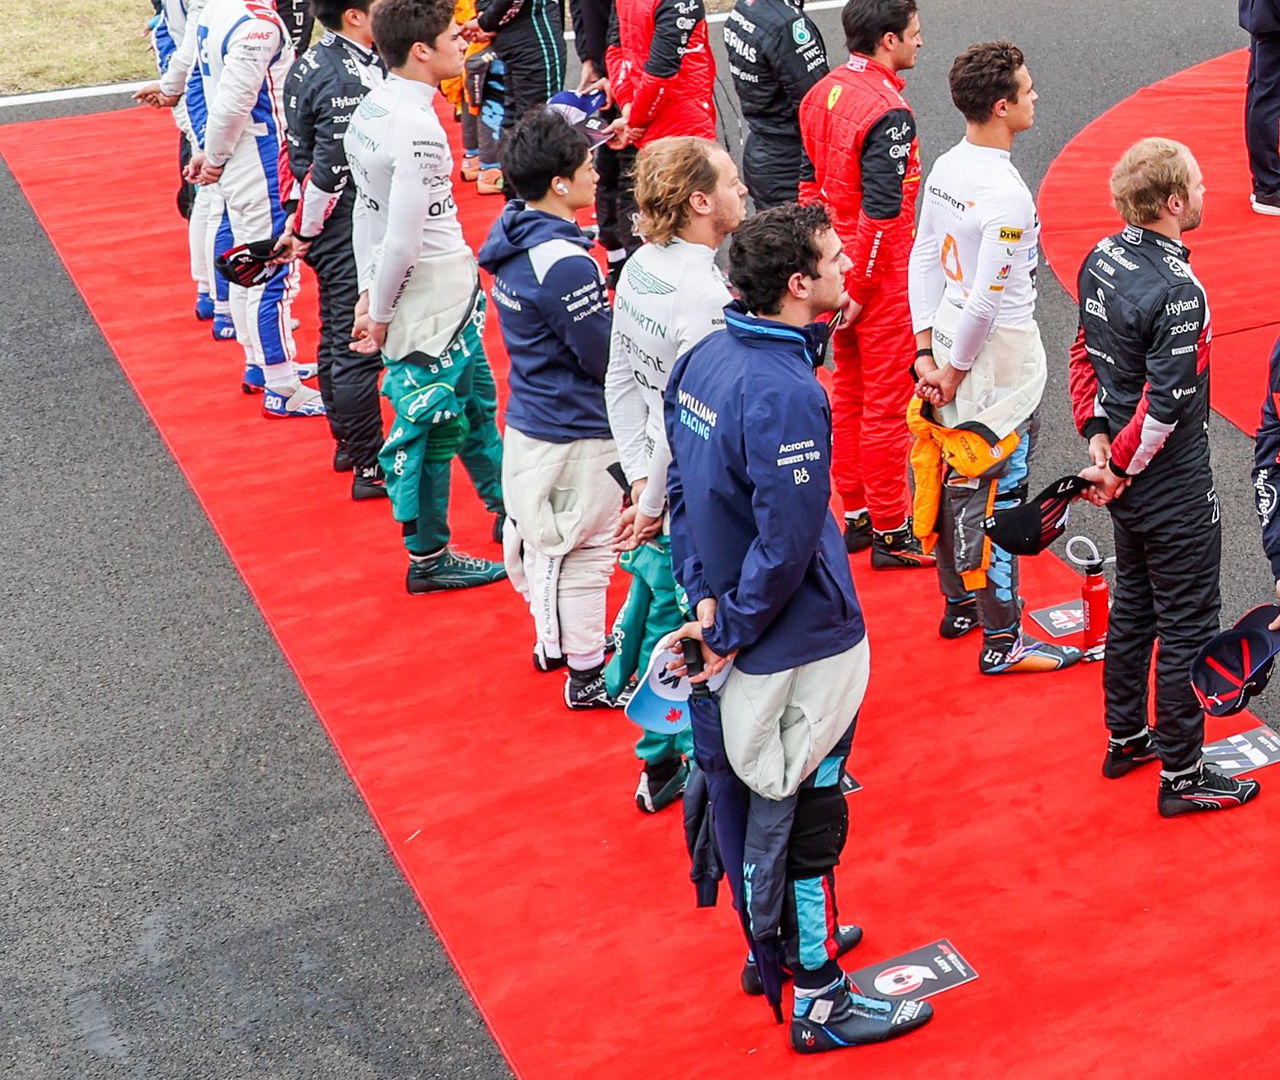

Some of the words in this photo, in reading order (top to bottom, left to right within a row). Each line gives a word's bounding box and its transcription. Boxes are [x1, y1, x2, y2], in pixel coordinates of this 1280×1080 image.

[1166, 296, 1199, 316] Hyland
[265, 395, 282, 410] 20
[678, 390, 717, 427] WILLIAMS
[680, 409, 711, 440] RACING
[779, 440, 815, 454] Acronis
